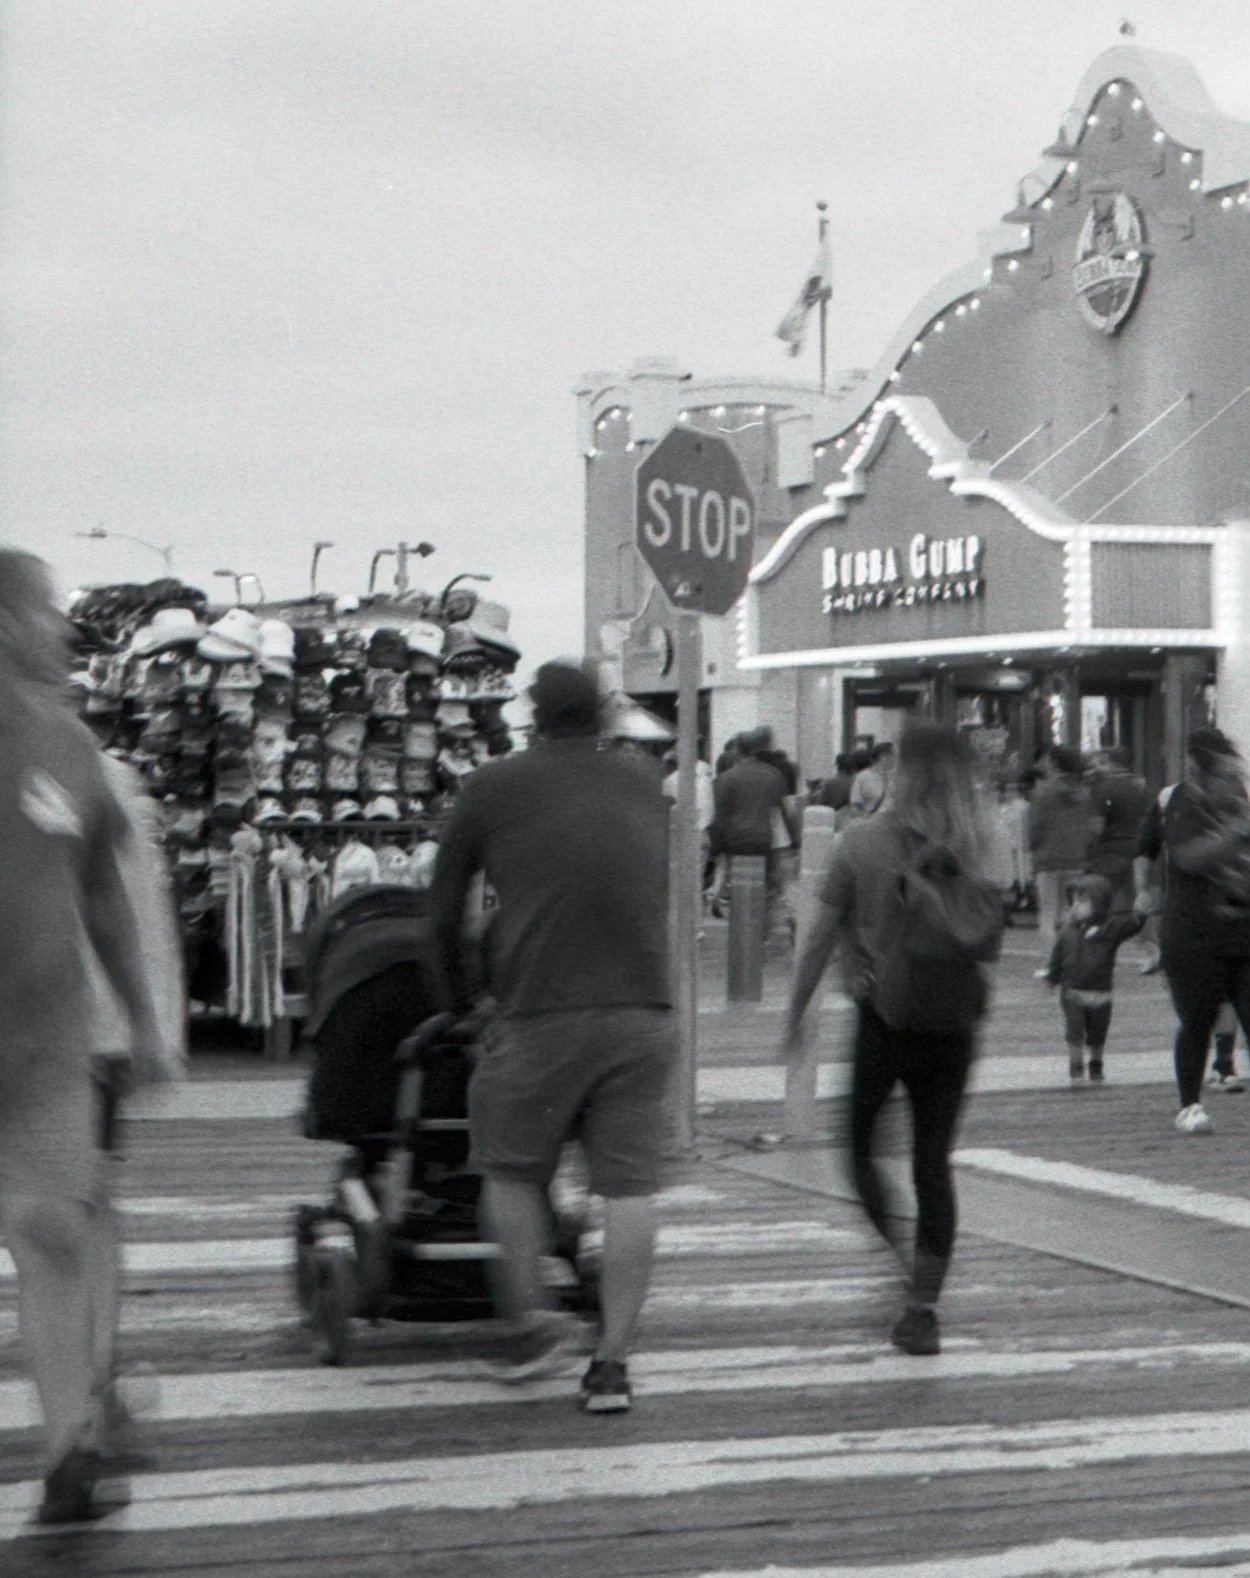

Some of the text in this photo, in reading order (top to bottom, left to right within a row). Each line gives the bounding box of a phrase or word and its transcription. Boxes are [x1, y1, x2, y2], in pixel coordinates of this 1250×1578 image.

[643, 477, 751, 562] STOP
[822, 532, 979, 590] BUBBA GUMP
